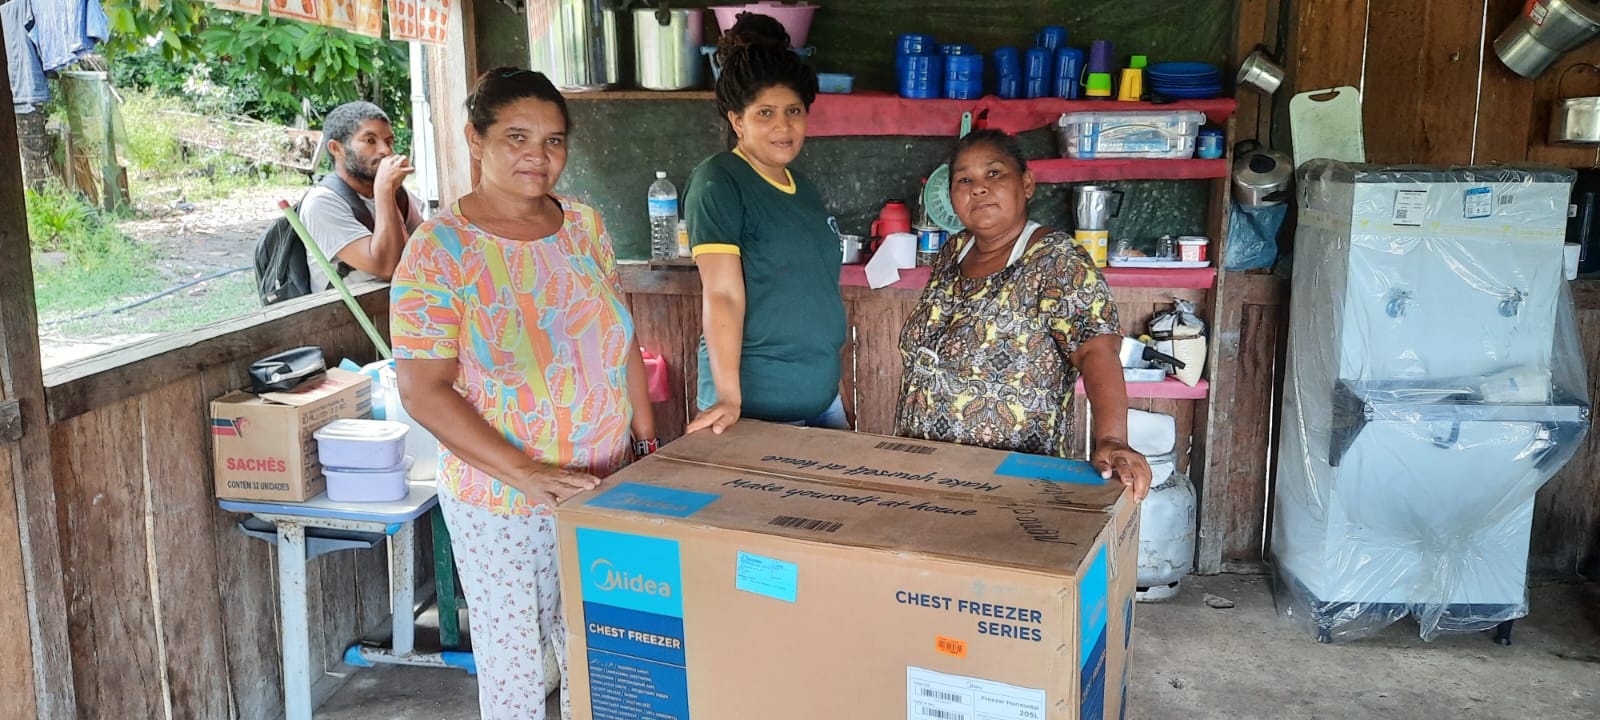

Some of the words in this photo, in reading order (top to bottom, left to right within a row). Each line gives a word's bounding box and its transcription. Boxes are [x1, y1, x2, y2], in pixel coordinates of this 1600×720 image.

[226, 457, 286, 473] SACHÊS
[761, 455, 819, 470] home
[816, 462, 847, 471] at
[842, 465, 938, 482] yourself
[260, 482, 290, 491] UNIDADES
[937, 478, 1002, 492] Make
[722, 478, 785, 492] Make
[780, 489, 881, 506] yourself
[877, 500, 911, 508] at
[908, 501, 978, 516] home
[590, 557, 672, 597] Midea
[895, 590, 953, 611] CHEST
[958, 599, 1042, 624] FREEZER
[588, 623, 625, 639] CHEST
[628, 630, 681, 649] FREEZER
[977, 621, 1042, 642] SERIES
